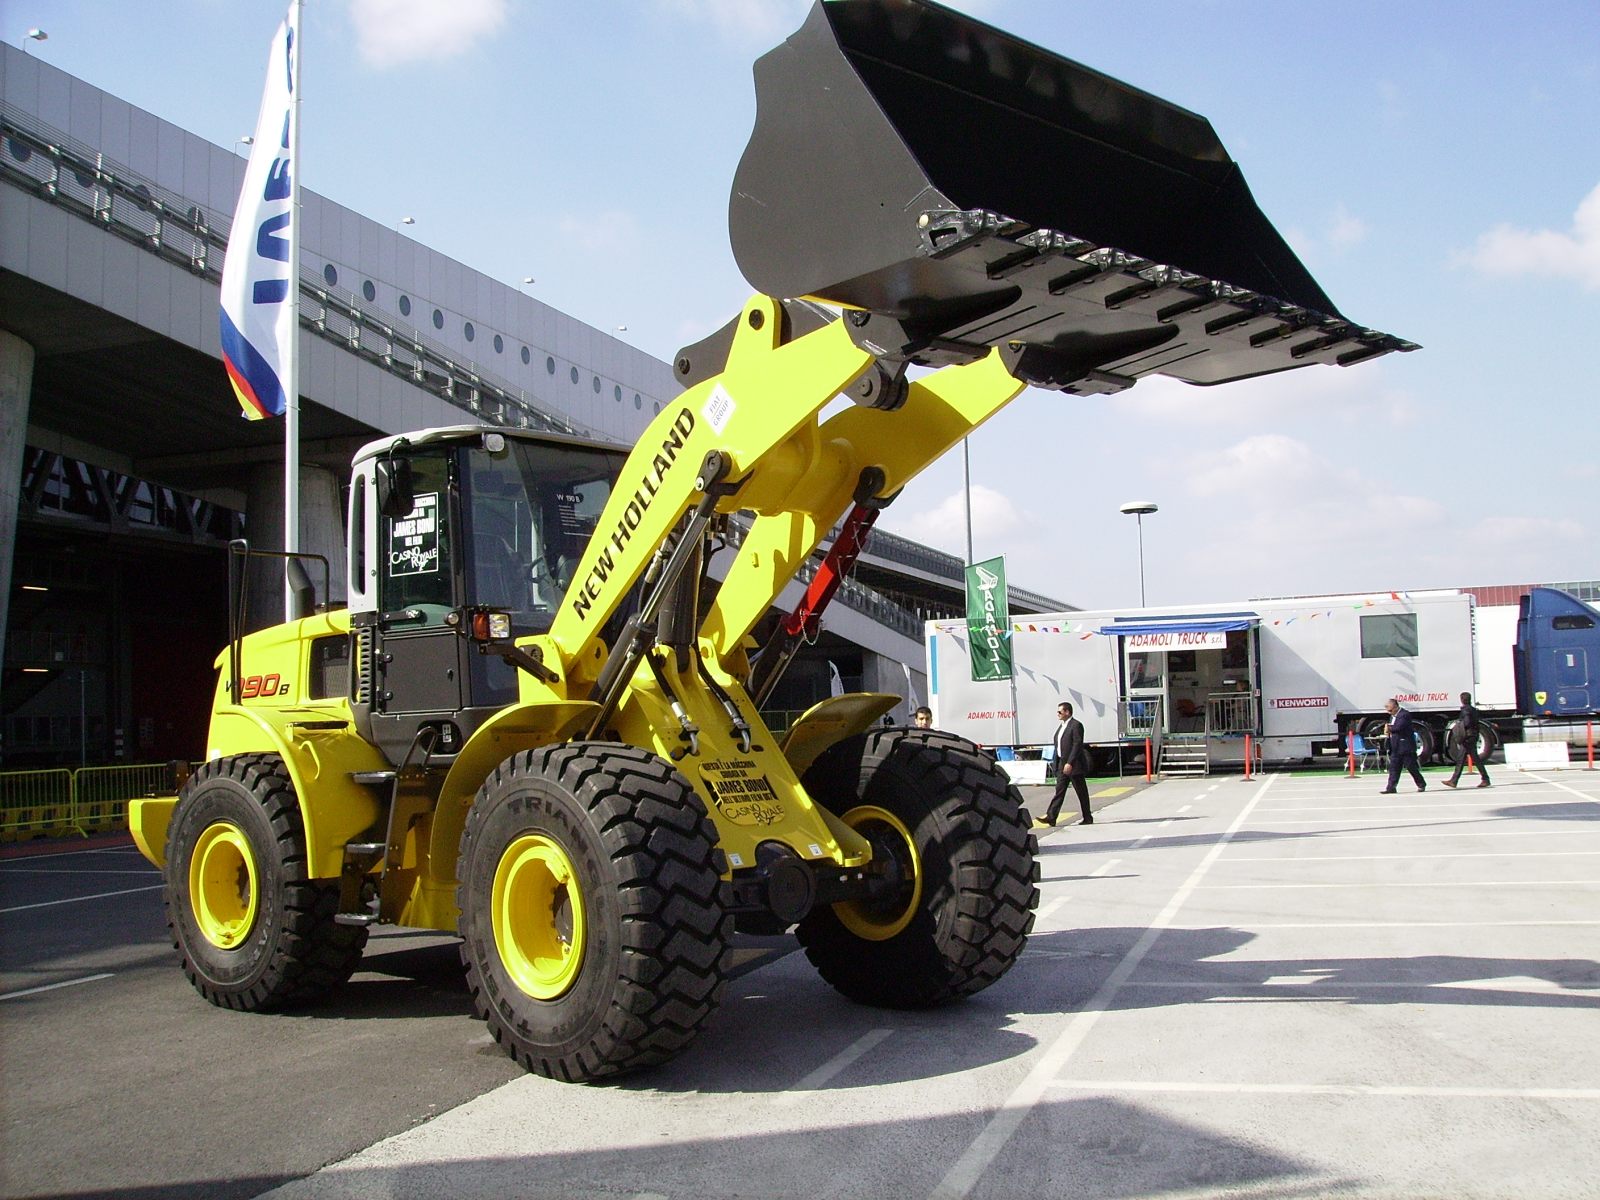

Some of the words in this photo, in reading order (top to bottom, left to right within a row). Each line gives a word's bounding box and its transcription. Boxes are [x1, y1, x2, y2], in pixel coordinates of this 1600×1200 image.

[712, 399, 730, 427] GROUP
[572, 547, 614, 621] NEW
[610, 407, 696, 554] HOLLAND
[394, 520, 416, 537] JAMES
[417, 518, 435, 534] BOND
[391, 546, 421, 565] CASINO
[410, 548, 437, 568] ROYALE
[1130, 632, 1174, 647] ADAMOLI
[1177, 631, 1208, 645] TRUCK
[279, 683, 290, 695] B
[1427, 692, 1449, 702] TRUCK
[1278, 697, 1328, 708] KENWORTH
[967, 711, 996, 720] ADAMOLI
[996, 710, 1017, 719] TRUCK
[716, 779, 745, 795] JAMES
[742, 778, 769, 793] BOND
[725, 802, 760, 819] CASINO
[753, 804, 785, 824] ROYALE
